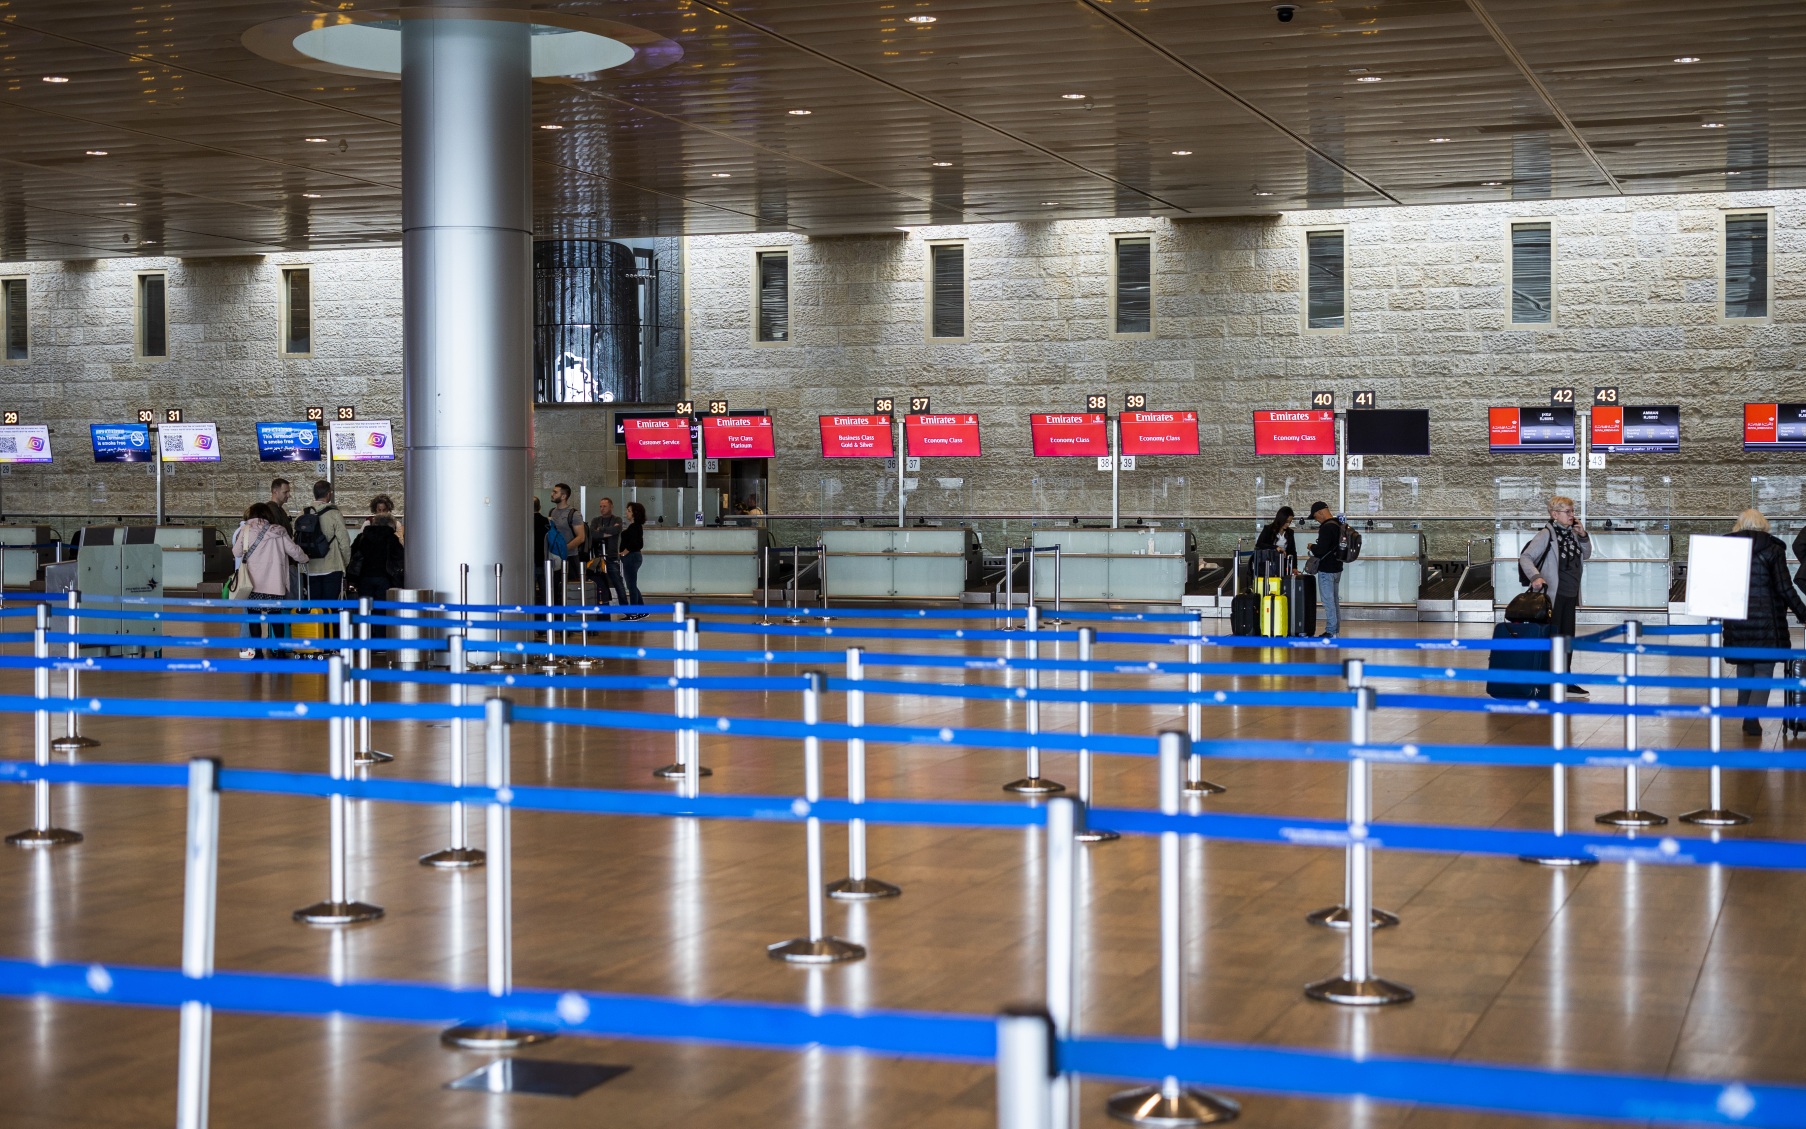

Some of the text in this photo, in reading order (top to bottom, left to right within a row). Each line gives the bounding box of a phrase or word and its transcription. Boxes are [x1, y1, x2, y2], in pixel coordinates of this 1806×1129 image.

[1314, 393, 1332, 405] 40
[1355, 392, 1373, 405] 41
[1553, 389, 1572, 402] 42
[1596, 389, 1617, 402] 43
[876, 400, 892, 411] 36
[912, 399, 928, 410] 37
[1088, 396, 1106, 408] 38
[1127, 396, 1144, 408] 39
[676, 402, 692, 414] 34
[710, 402, 726, 414] 35
[4, 412, 18, 424] 29
[139, 410, 152, 422] 30
[168, 410, 180, 422] 31
[308, 408, 322, 420] 32
[338, 408, 353, 419] 33
[1136, 413, 1174, 422] Emirates
[1270, 412, 1309, 421] Emirates
[636, 420, 670, 428] Emirates
[717, 418, 750, 426] Emirates
[834, 417, 869, 425] Emirates
[920, 416, 956, 424] Emirates
[1046, 416, 1083, 424] Emirates
[687, 461, 695, 469] 34
[708, 461, 716, 469] 35
[887, 460, 896, 468] 36
[909, 460, 917, 468] 37
[1100, 459, 1109, 467] 38
[1123, 458, 1132, 467] 39
[1326, 458, 1335, 467] 40
[1351, 458, 1359, 467] 41
[1566, 457, 1576, 466] 42
[1592, 456, 1602, 465] 43
[2, 465, 9, 474] 29
[148, 465, 156, 473] 30
[166, 464, 173, 473] 31
[318, 464, 326, 472] 32
[336, 464, 344, 472] 33
